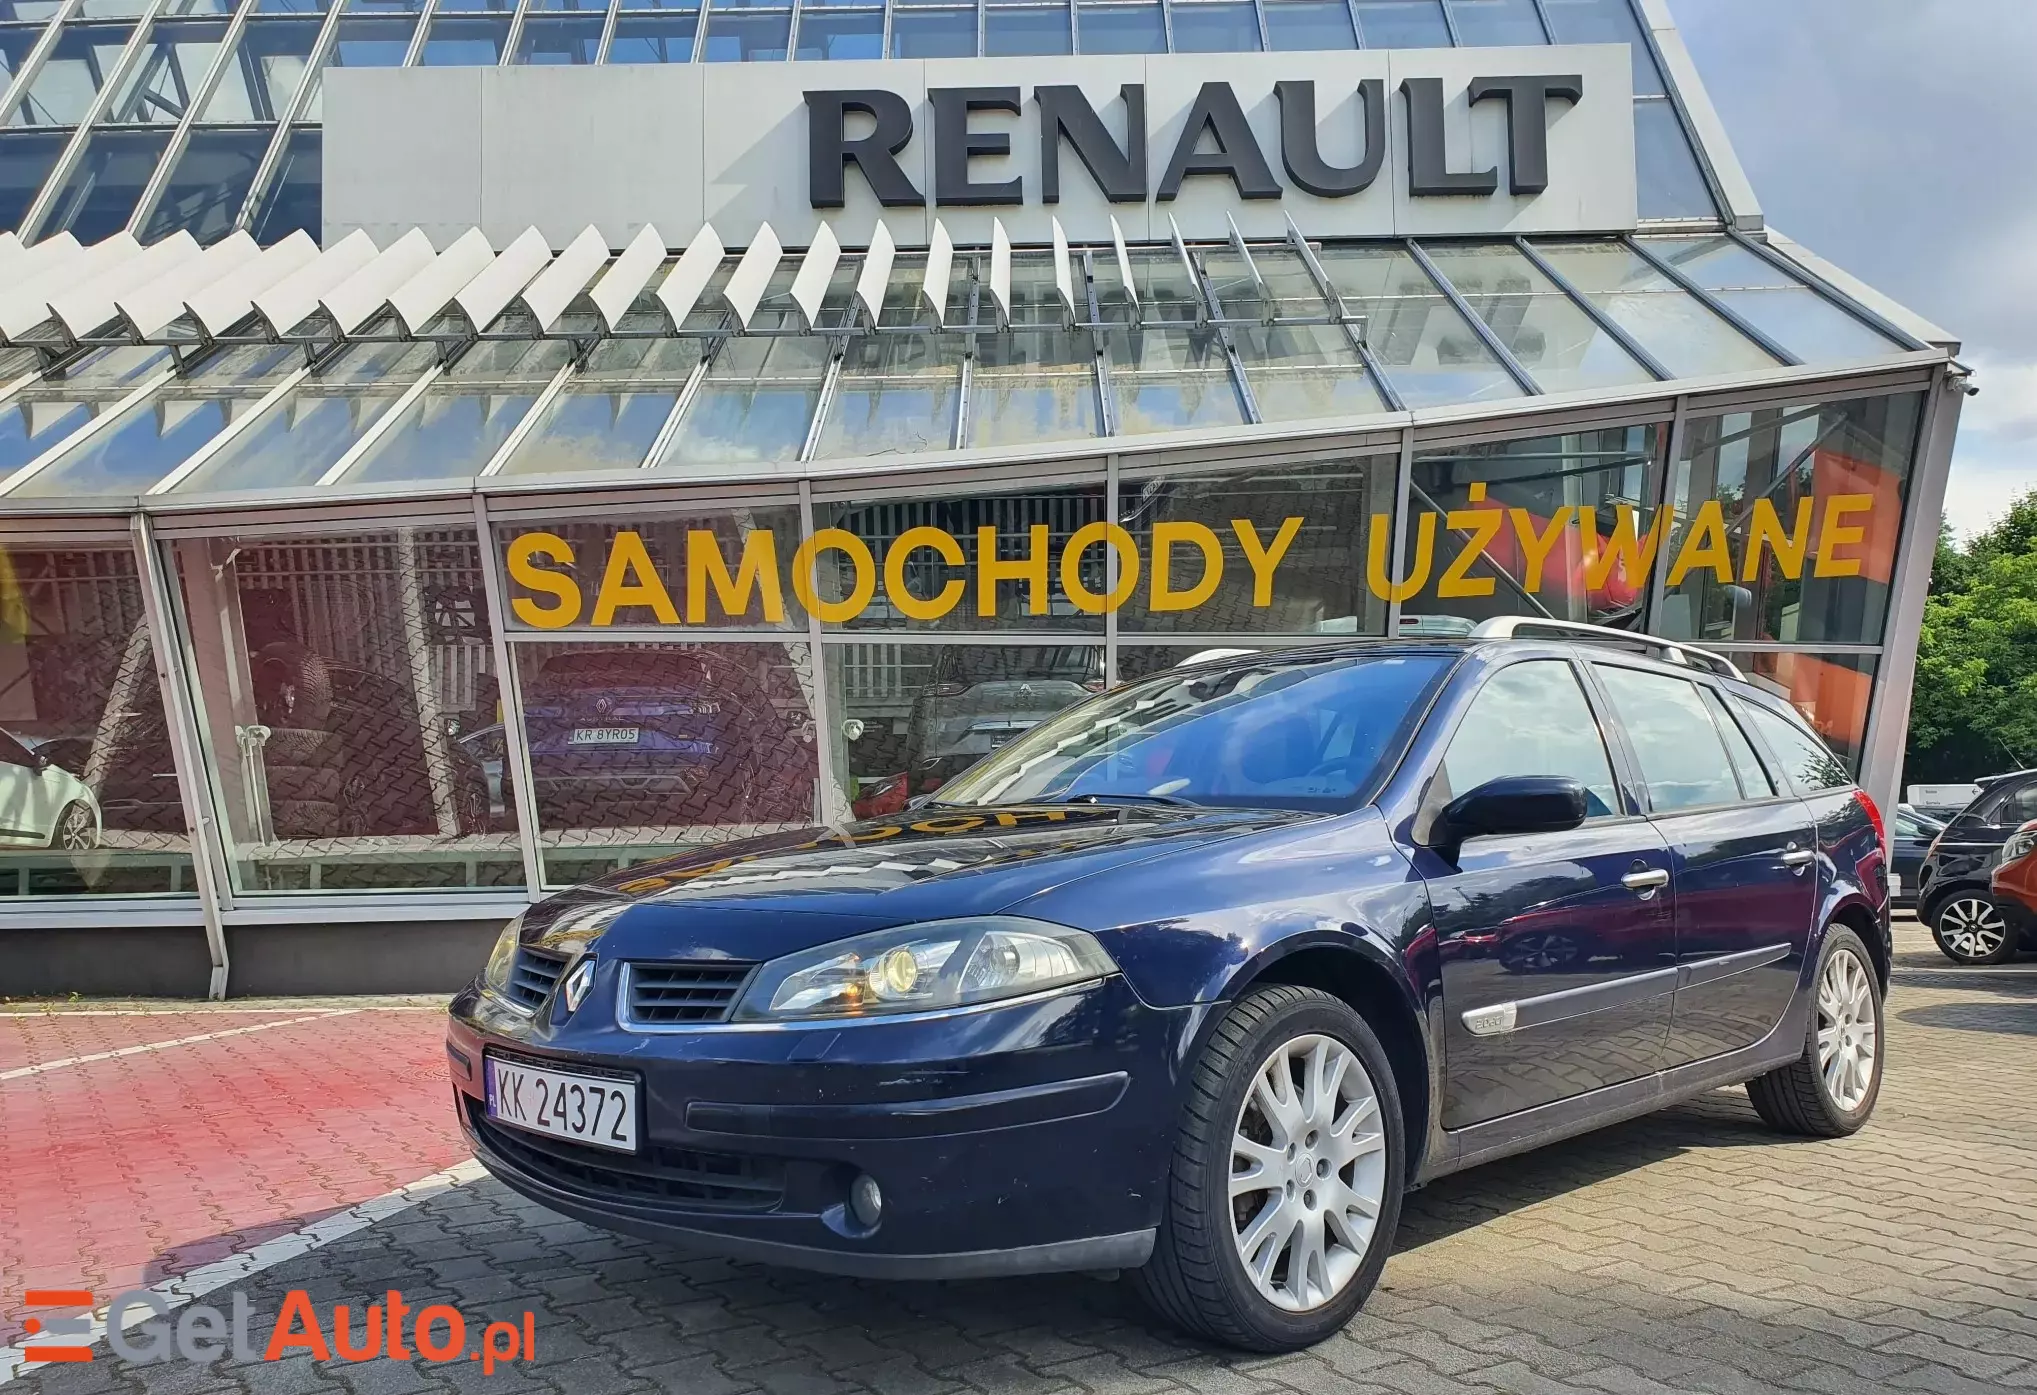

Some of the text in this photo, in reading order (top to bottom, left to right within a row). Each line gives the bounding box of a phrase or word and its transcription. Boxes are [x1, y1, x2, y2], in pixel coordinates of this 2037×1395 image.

[803, 74, 1584, 210] RENAULT
[507, 482, 1874, 628] SAMOCHODY UŻYWANE
[576, 729, 592, 741] KR
[498, 1068, 628, 1142] KK 24372
